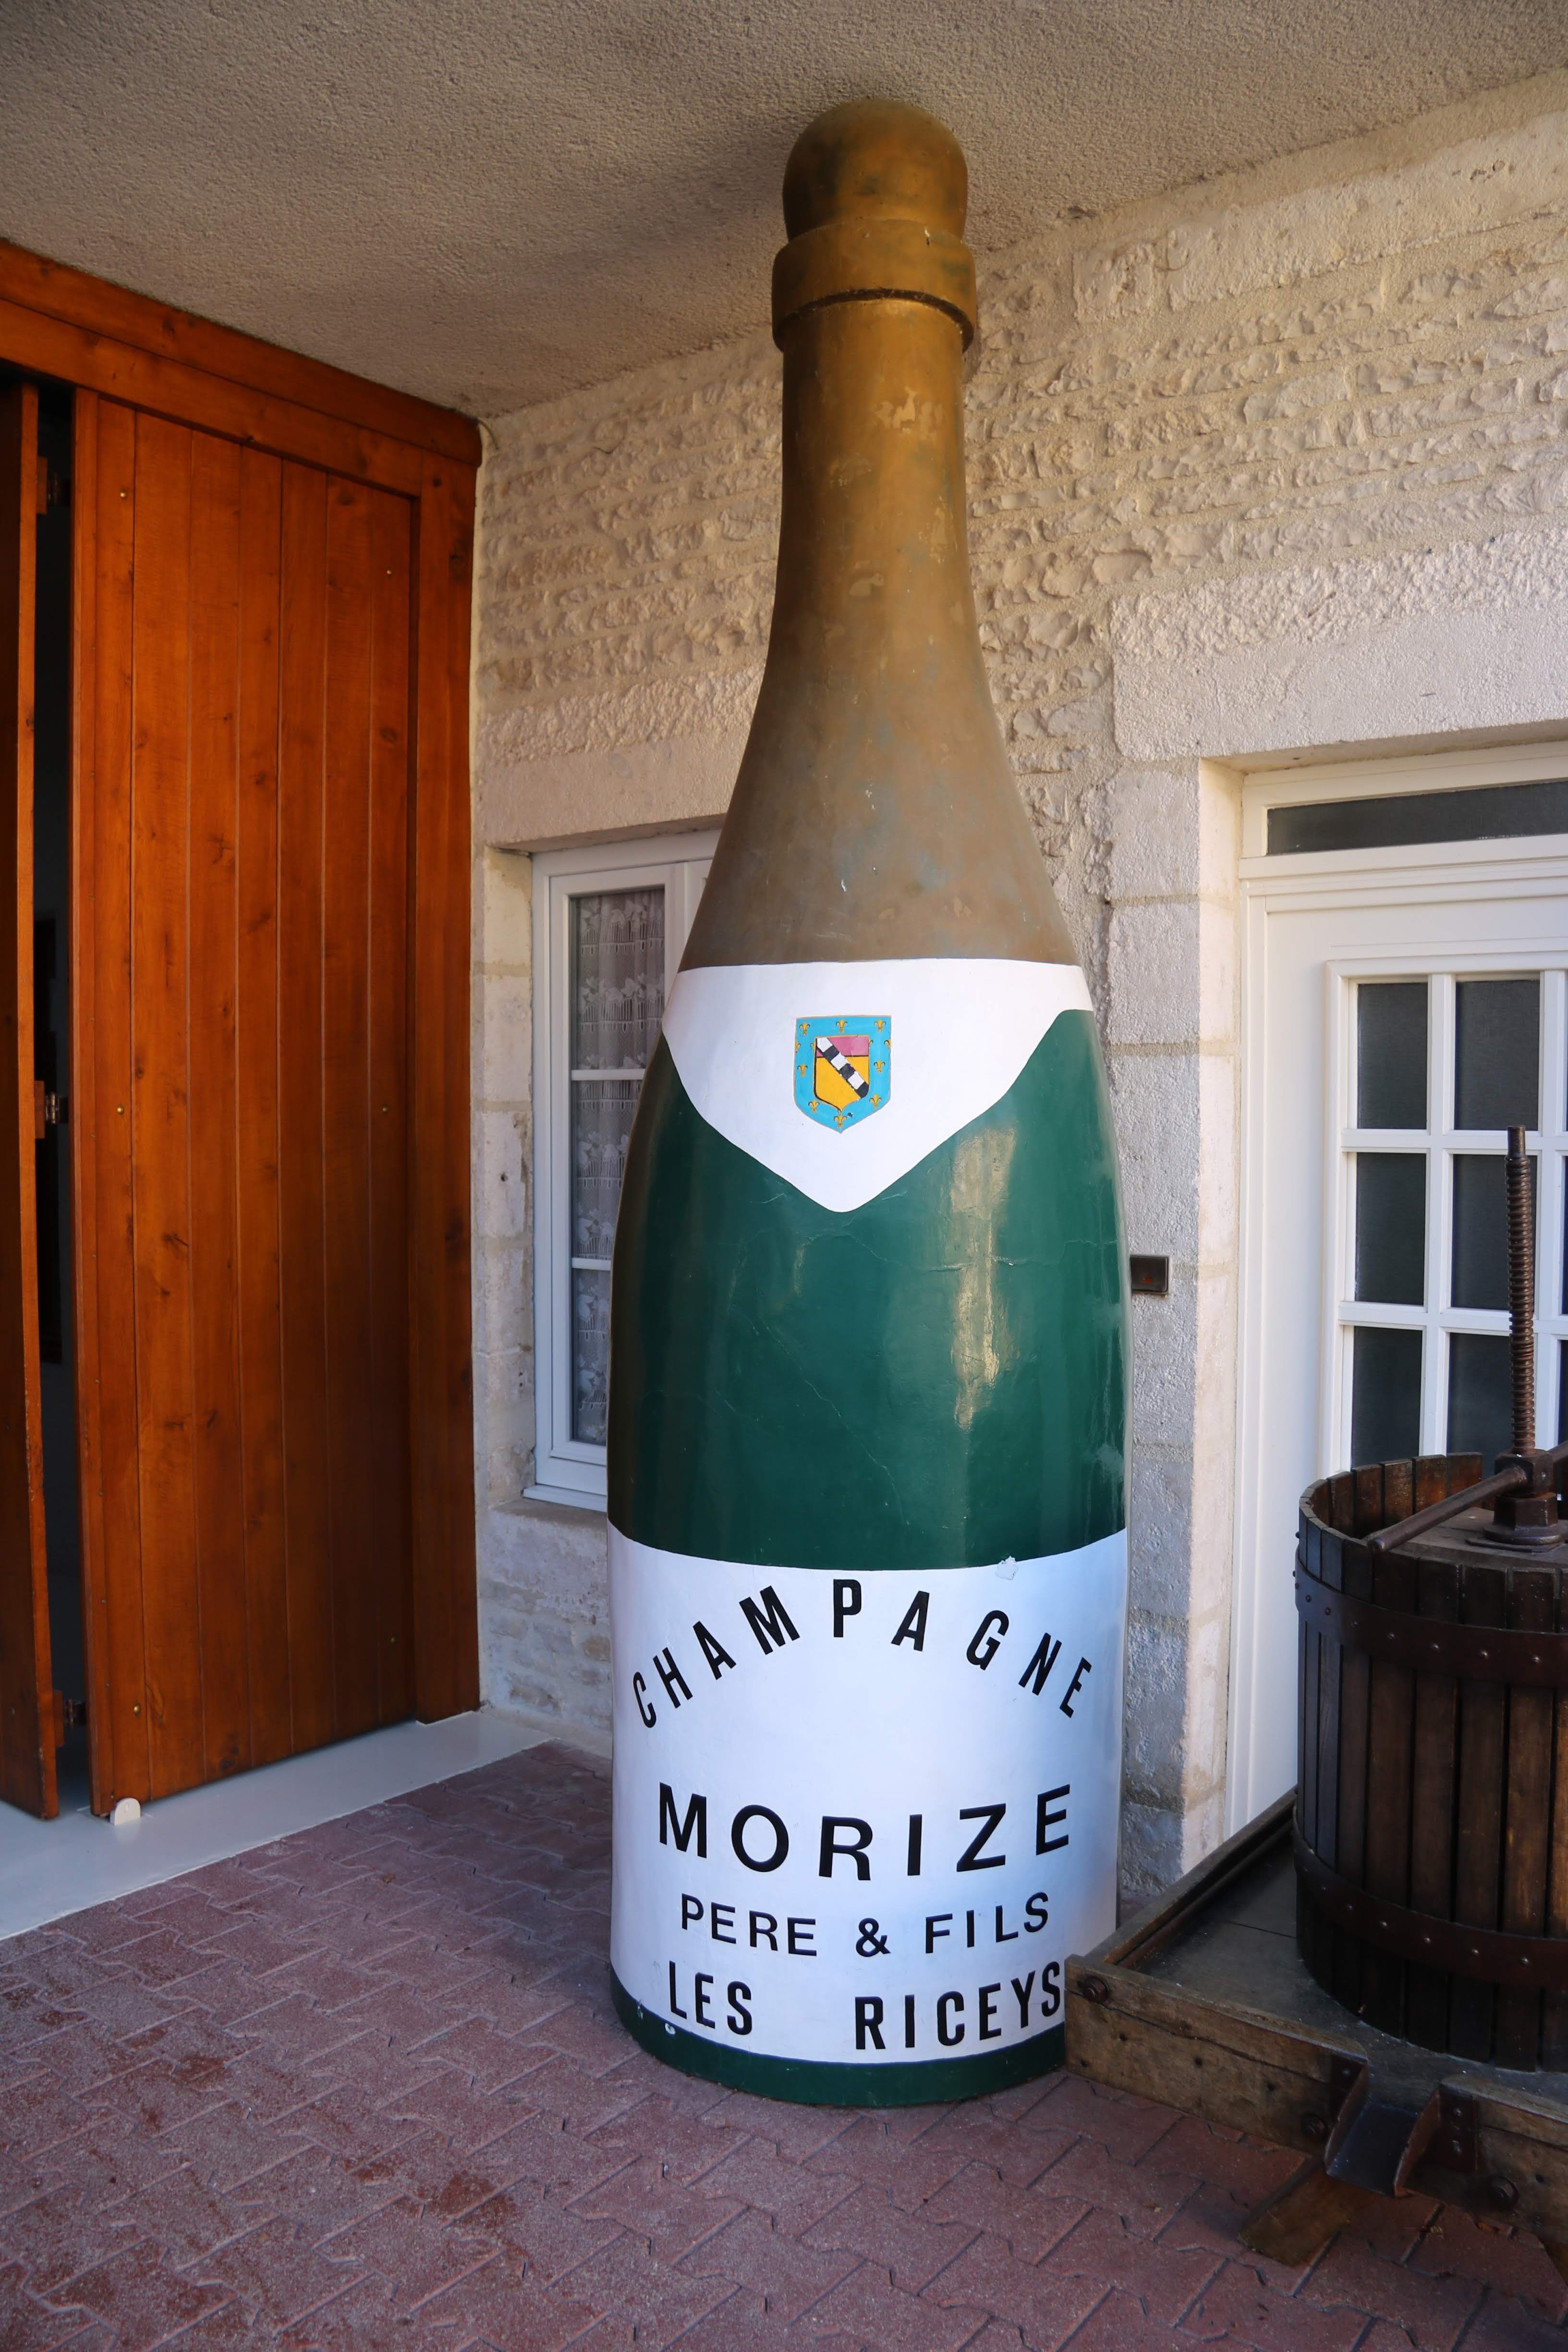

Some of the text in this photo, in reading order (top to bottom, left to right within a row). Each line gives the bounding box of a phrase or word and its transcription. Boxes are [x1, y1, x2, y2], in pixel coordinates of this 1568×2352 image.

[632, 1578, 1093, 1729] CHAMPAGNE
[659, 1782, 1070, 1881] MORIZE
[681, 1891, 1049, 1958] PERE & FILS
[669, 1960, 1062, 2050] LES RICEYS
